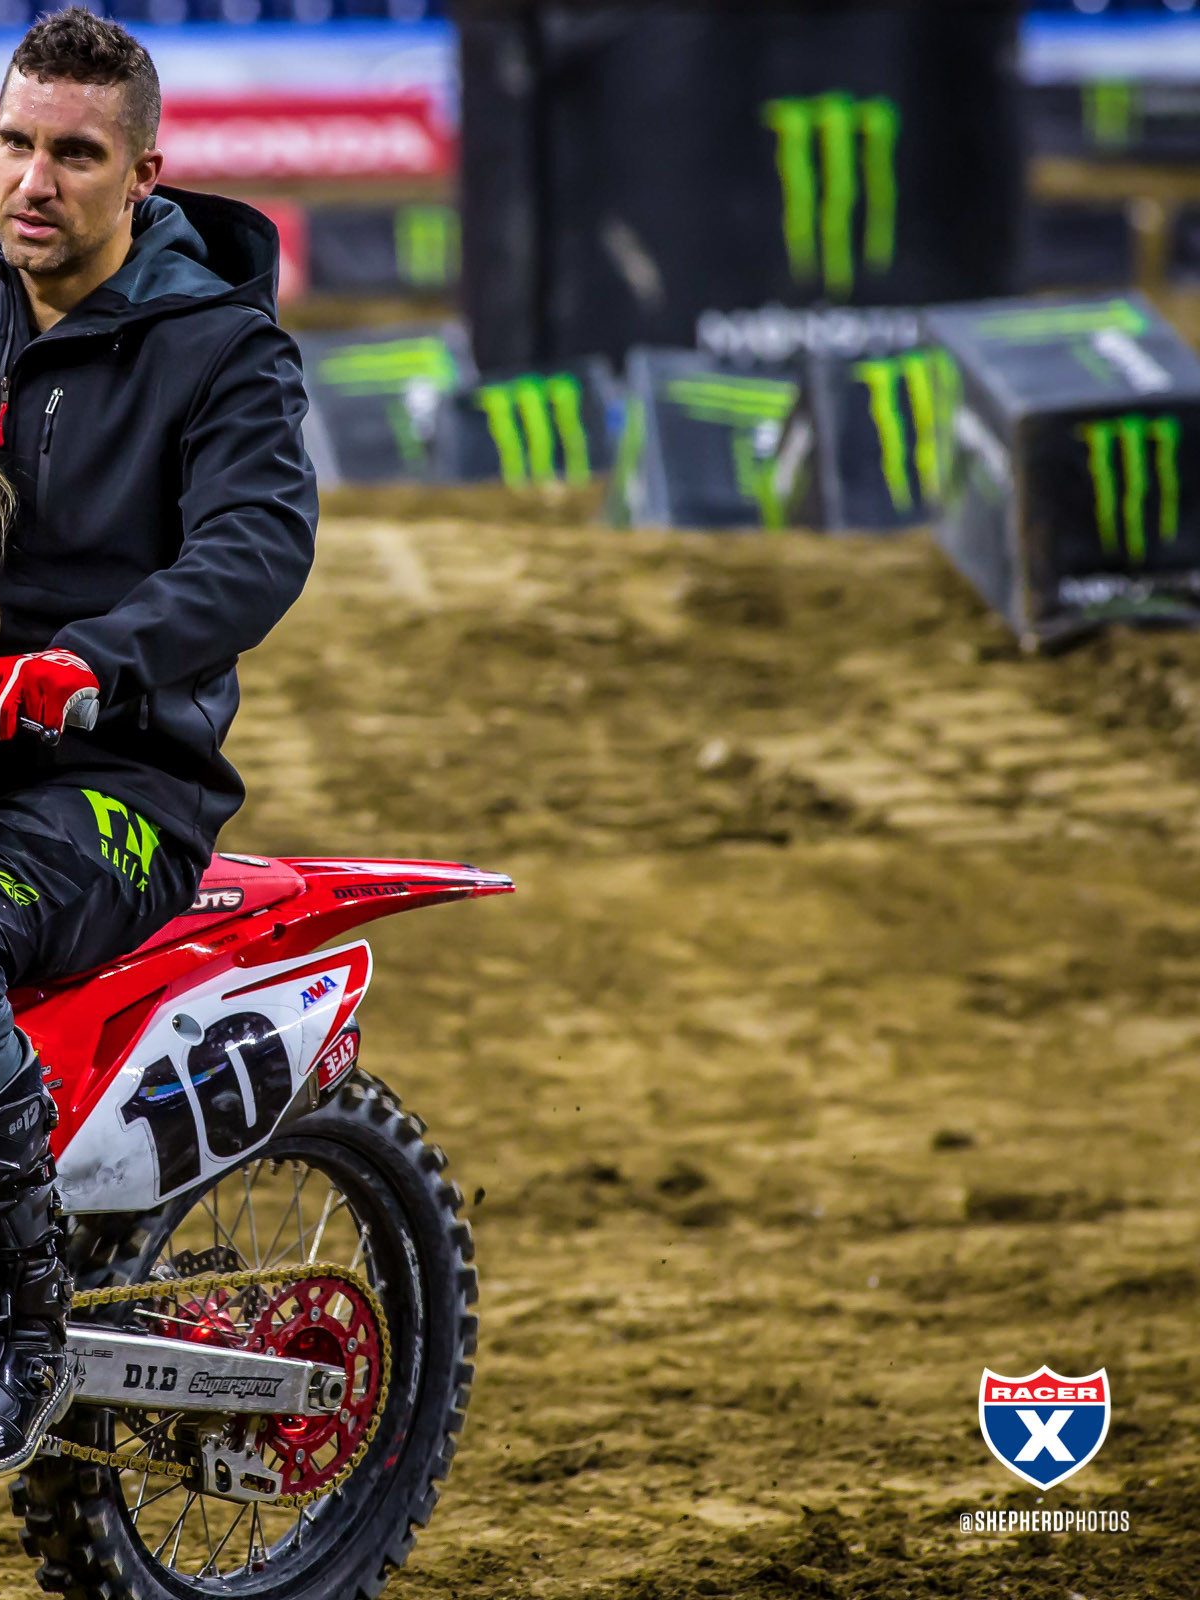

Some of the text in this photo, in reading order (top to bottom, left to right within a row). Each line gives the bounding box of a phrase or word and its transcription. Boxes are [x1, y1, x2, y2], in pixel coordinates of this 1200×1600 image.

[188, 890, 242, 909] UTS
[299, 974, 339, 1011] AMA
[120, 1011, 293, 1198] 10
[188, 1371, 284, 1400] Supersprox
